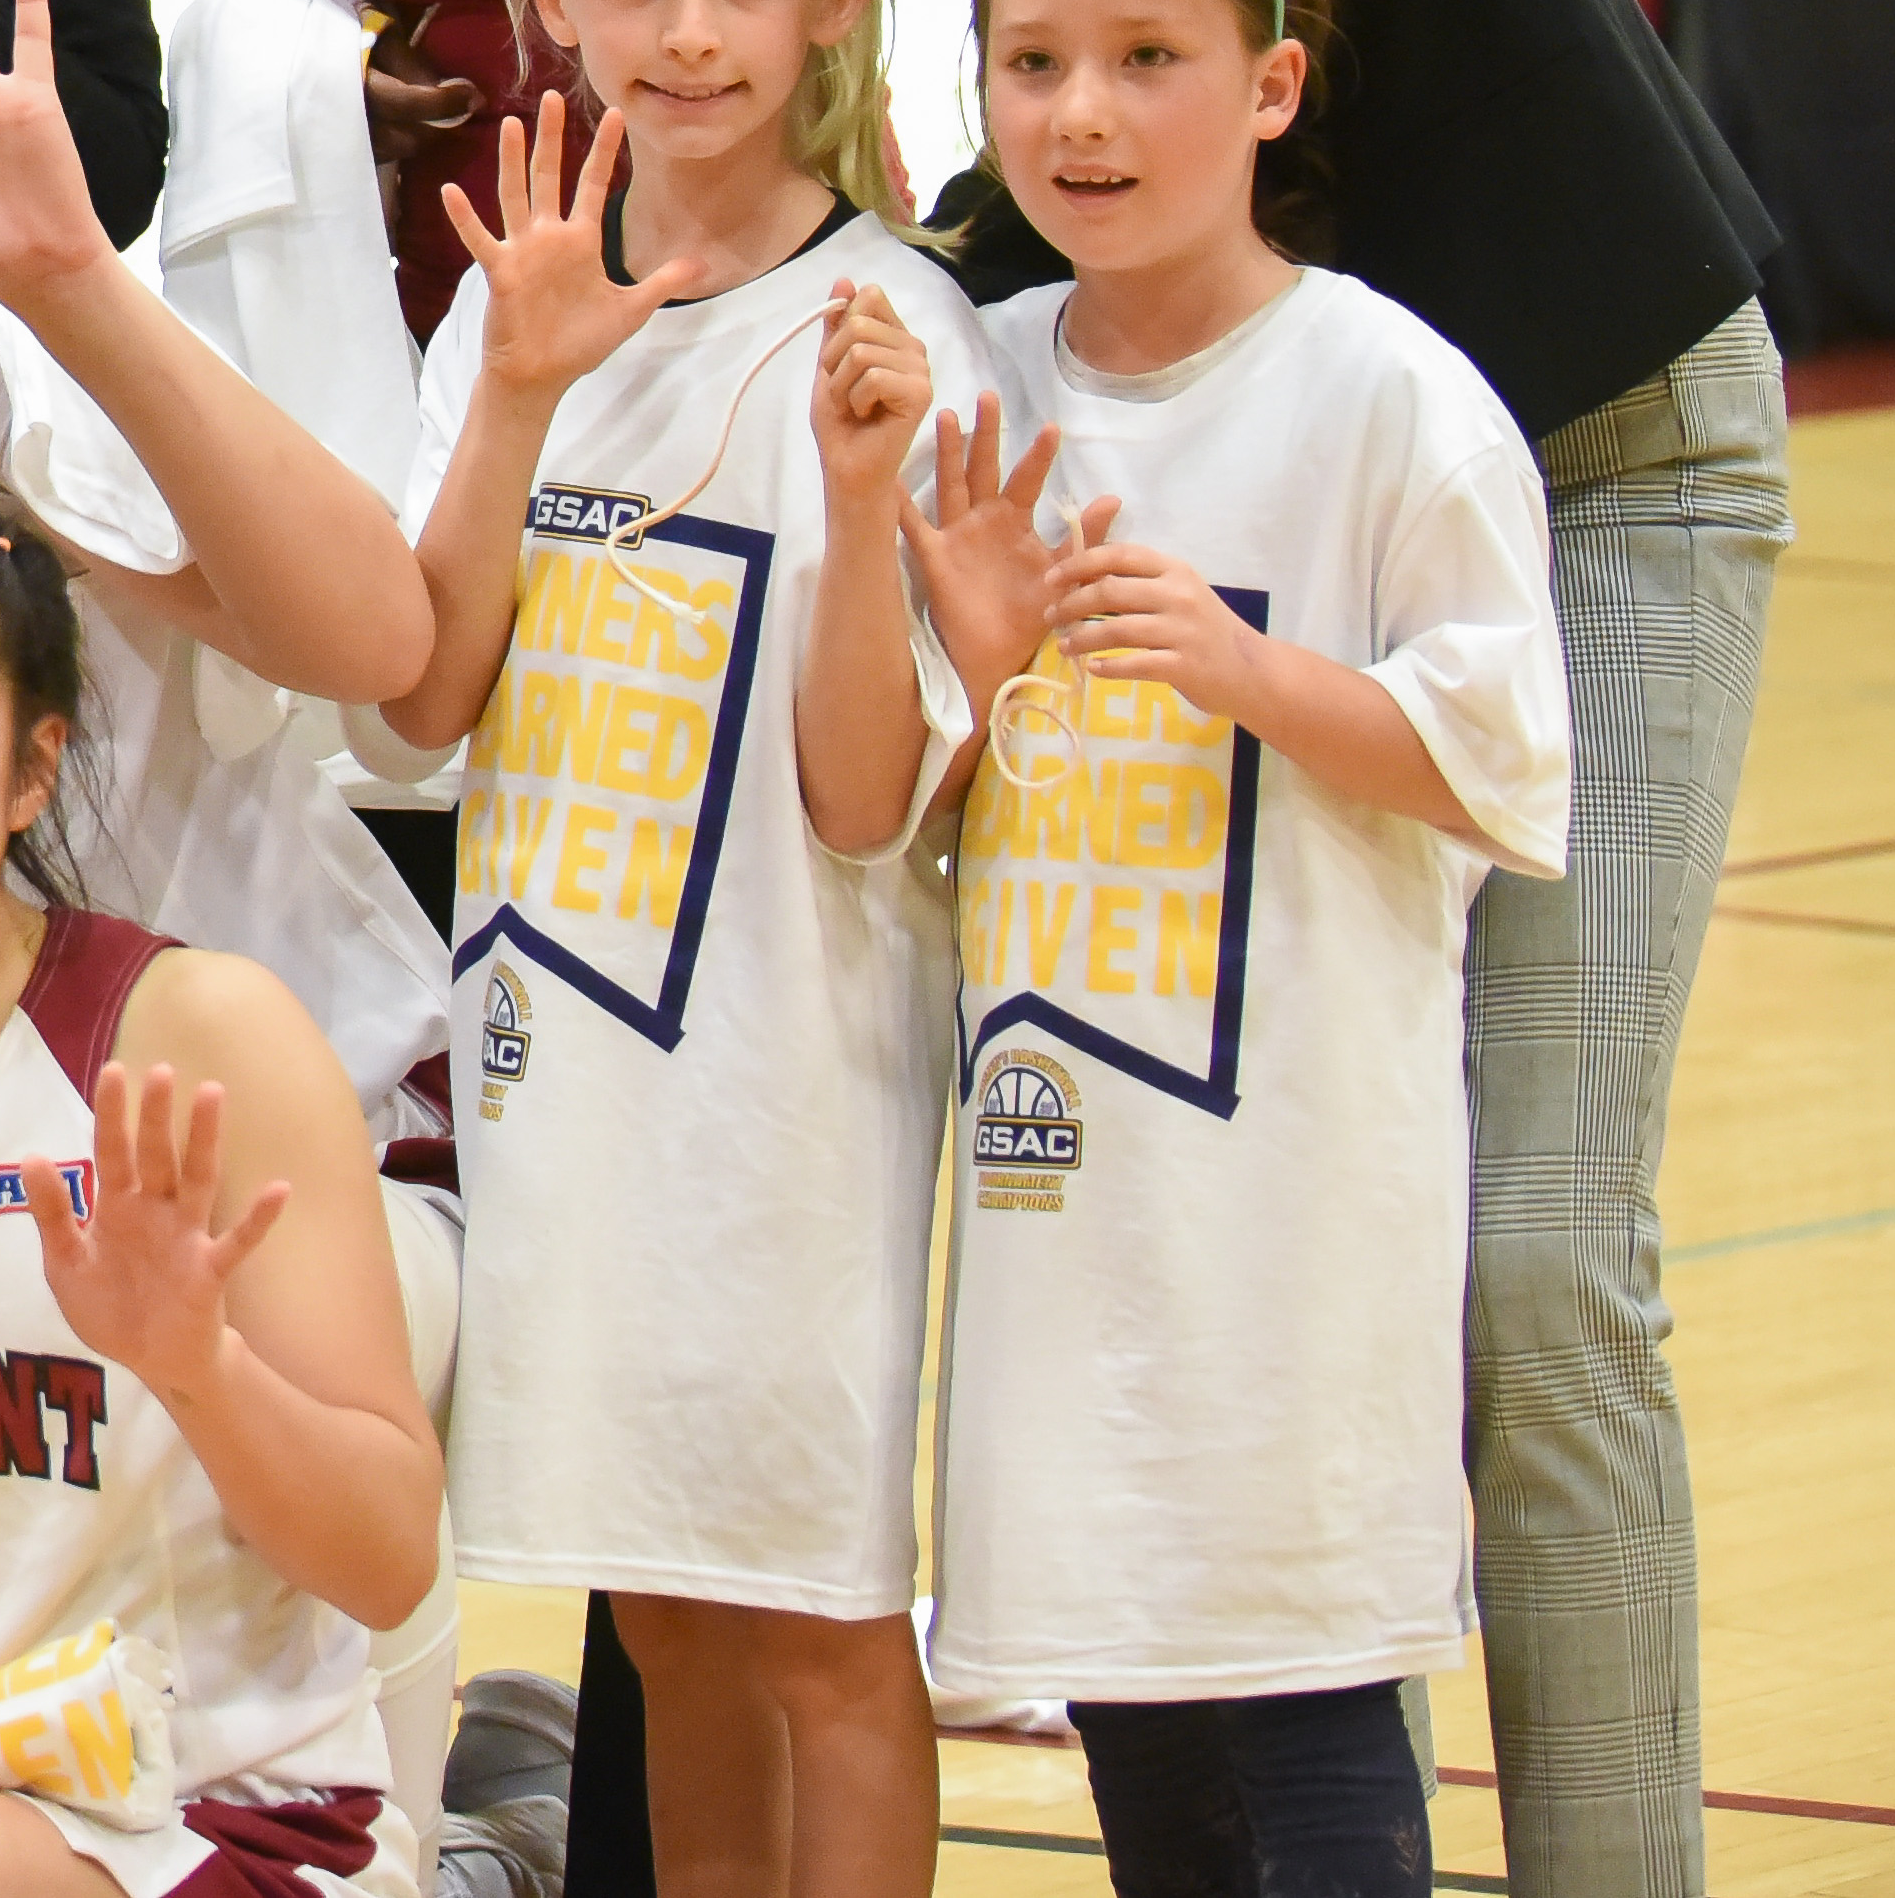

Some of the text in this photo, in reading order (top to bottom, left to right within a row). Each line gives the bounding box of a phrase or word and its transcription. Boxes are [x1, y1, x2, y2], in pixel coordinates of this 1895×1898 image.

[534, 492, 641, 539] GSAC
[960, 753, 1227, 870] EARNED
[459, 787, 696, 929] GIVEN
[962, 876, 1221, 997] GIVEN
[483, 1032, 524, 1069] AC
[976, 1125, 1075, 1159] GSAC
